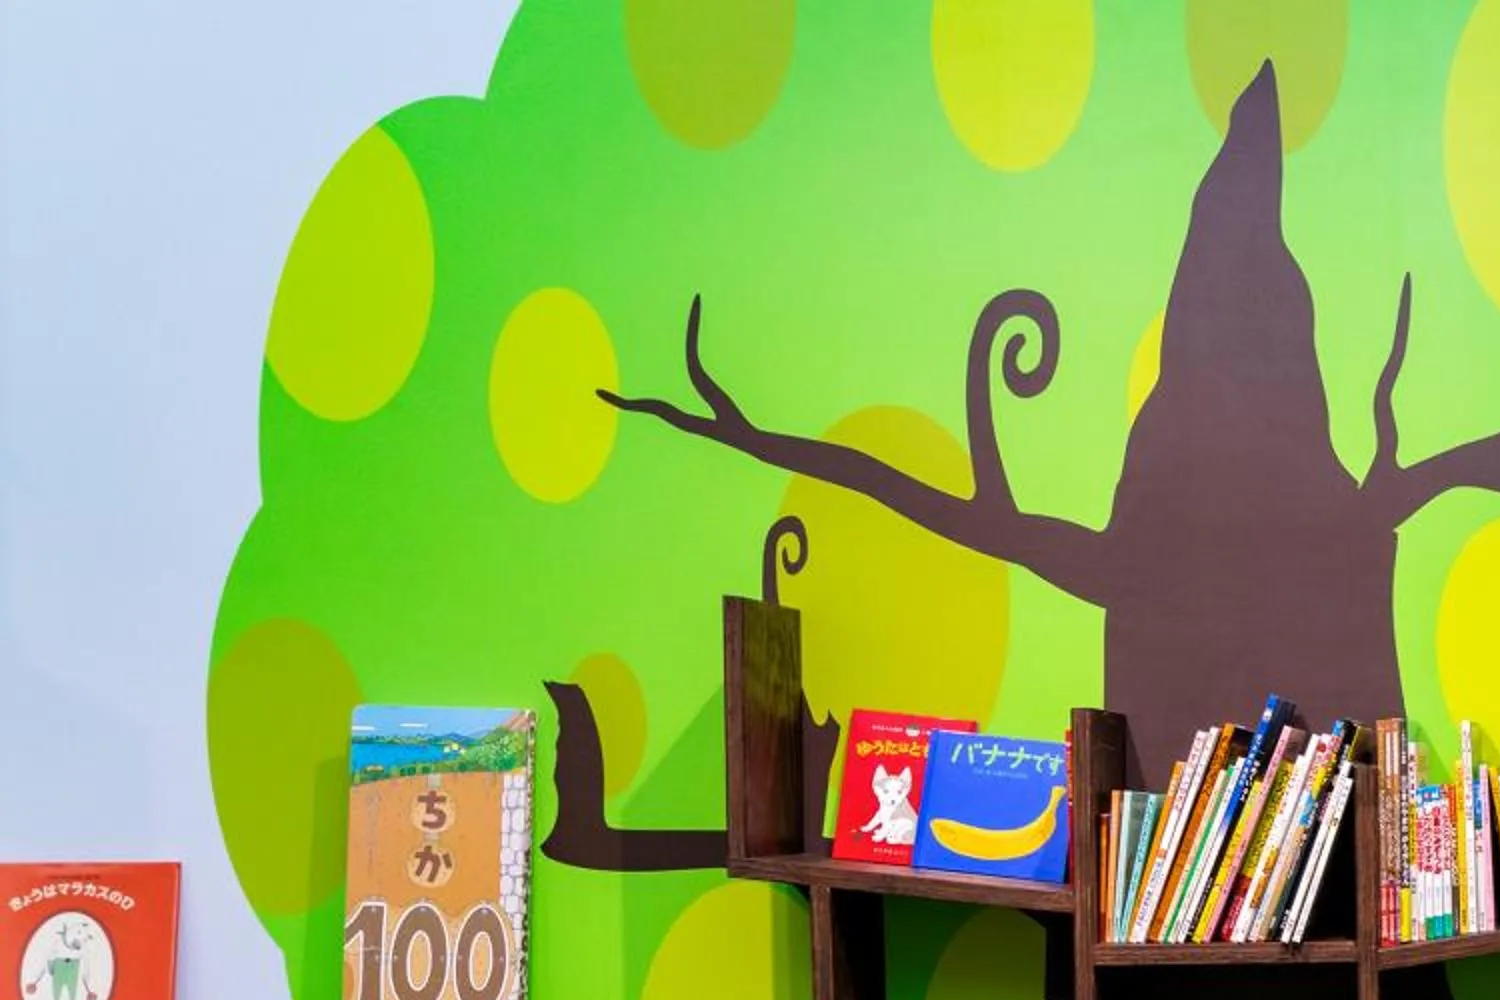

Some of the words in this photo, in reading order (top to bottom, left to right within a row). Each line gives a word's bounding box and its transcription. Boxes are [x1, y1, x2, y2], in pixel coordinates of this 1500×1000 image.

[951, 742, 1065, 777] バナナです
[414, 789, 453, 885] ちか
[8, 881, 136, 912] きょうはマラカスのひ
